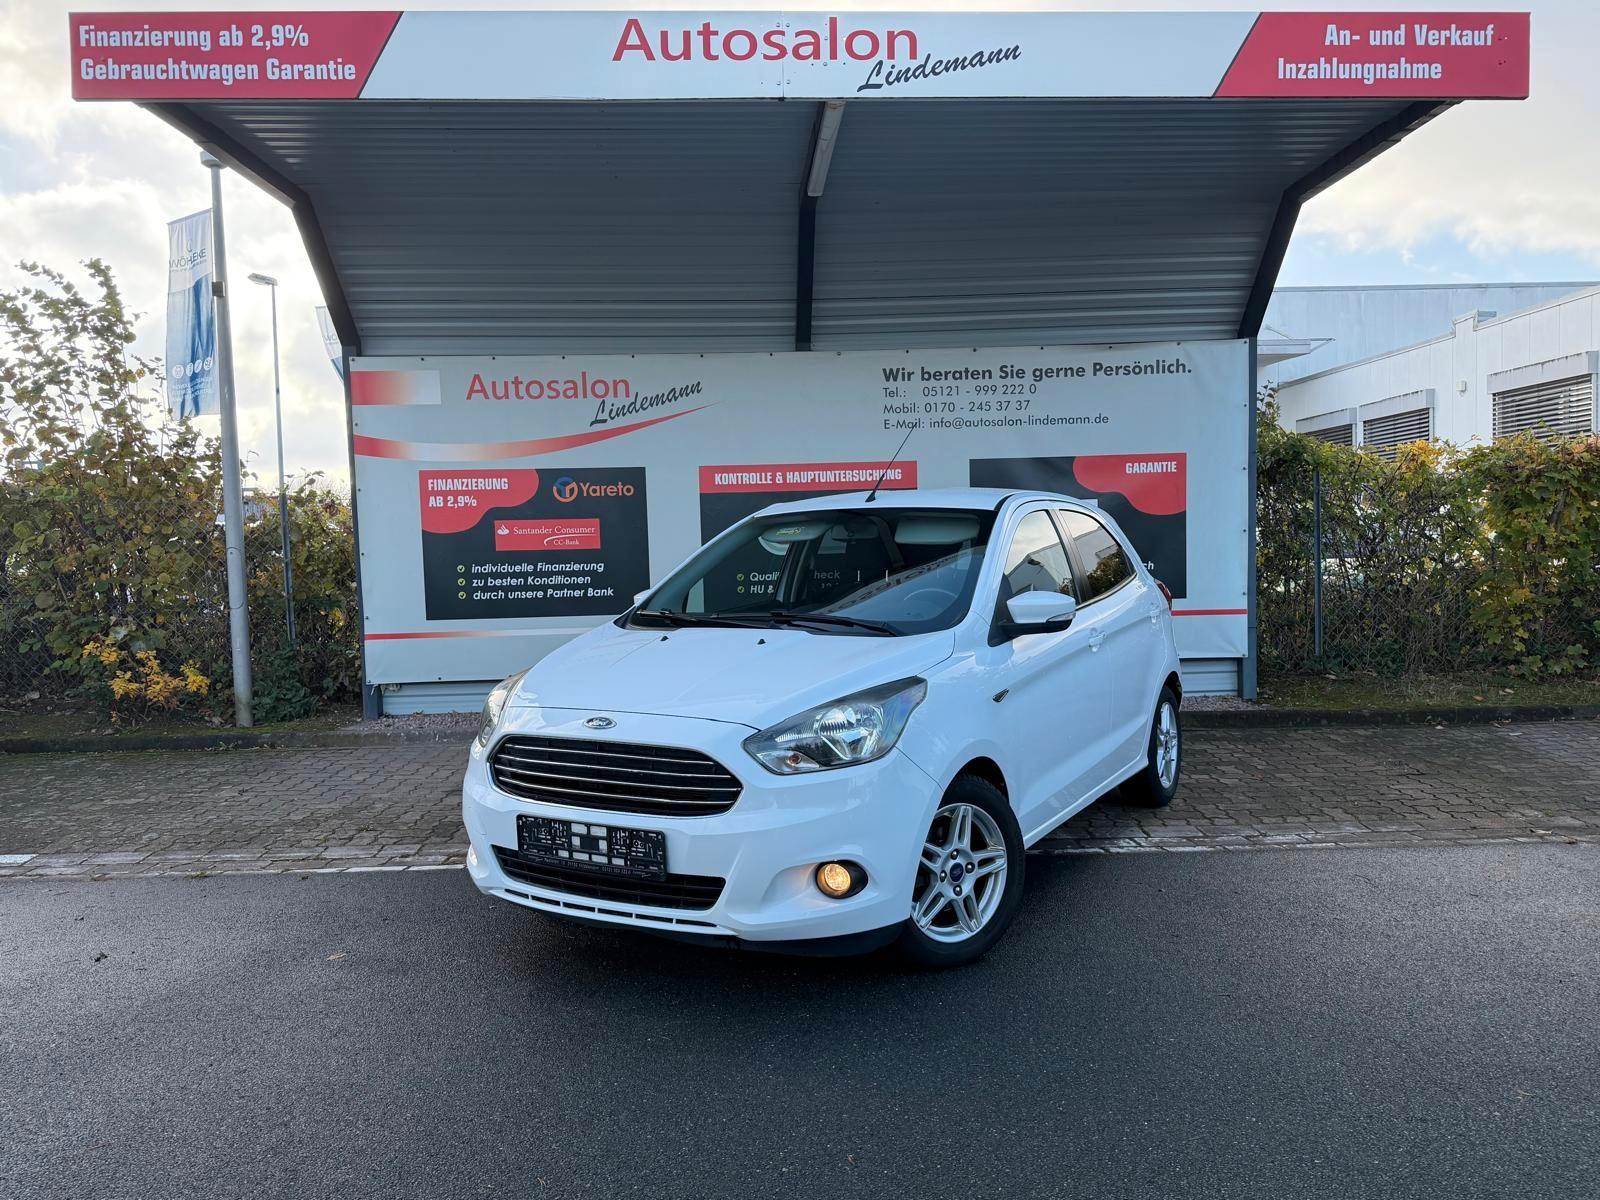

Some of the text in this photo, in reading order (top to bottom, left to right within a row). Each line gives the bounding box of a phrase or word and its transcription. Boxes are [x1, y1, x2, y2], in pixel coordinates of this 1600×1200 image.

[79, 25, 309, 51] Finanzierung ab 2,9%
[612, 16, 918, 61] Autosalon
[1324, 24, 1494, 46] An- und Verkauf
[80, 58, 356, 85] Gebrauchtwagen Garantie
[856, 44, 1021, 93] Lindemann
[1278, 57, 1442, 85] Inzahlungnahme
[882, 359, 1192, 382] Wir beraten Sie gerne Persönlich.
[466, 371, 630, 401] Autosalon
[883, 387, 906, 398] Tel.:
[922, 385, 961, 397] 05121
[974, 385, 998, 397] 999
[1001, 384, 1025, 396] 222
[1029, 383, 1037, 395] 0
[589, 380, 703, 428] Lindemann
[883, 402, 920, 415] Mobil:
[924, 401, 956, 413] 0170
[968, 401, 992, 413] 245
[995, 400, 1011, 412] 37
[1015, 400, 1031, 411] 37
[884, 413, 1109, 430] E-Mail: info@autosalon-lindemann.de
[1125, 461, 1177, 474] GARANTIE
[428, 478, 509, 491] FINANZIERUNG
[714, 468, 902, 485] KONTROLLE & HAUPTUNTERSUCHUNG
[579, 481, 634, 497] Yareto
[429, 495, 477, 509] AB 2,9%
[513, 525, 595, 535] Santander Consumer
[471, 562, 605, 574] individuelle Finanzierung
[472, 575, 591, 587] zu besten Konditionen
[473, 587, 614, 600] durch unsere Partner Bank
[750, 585, 764, 594] HU
